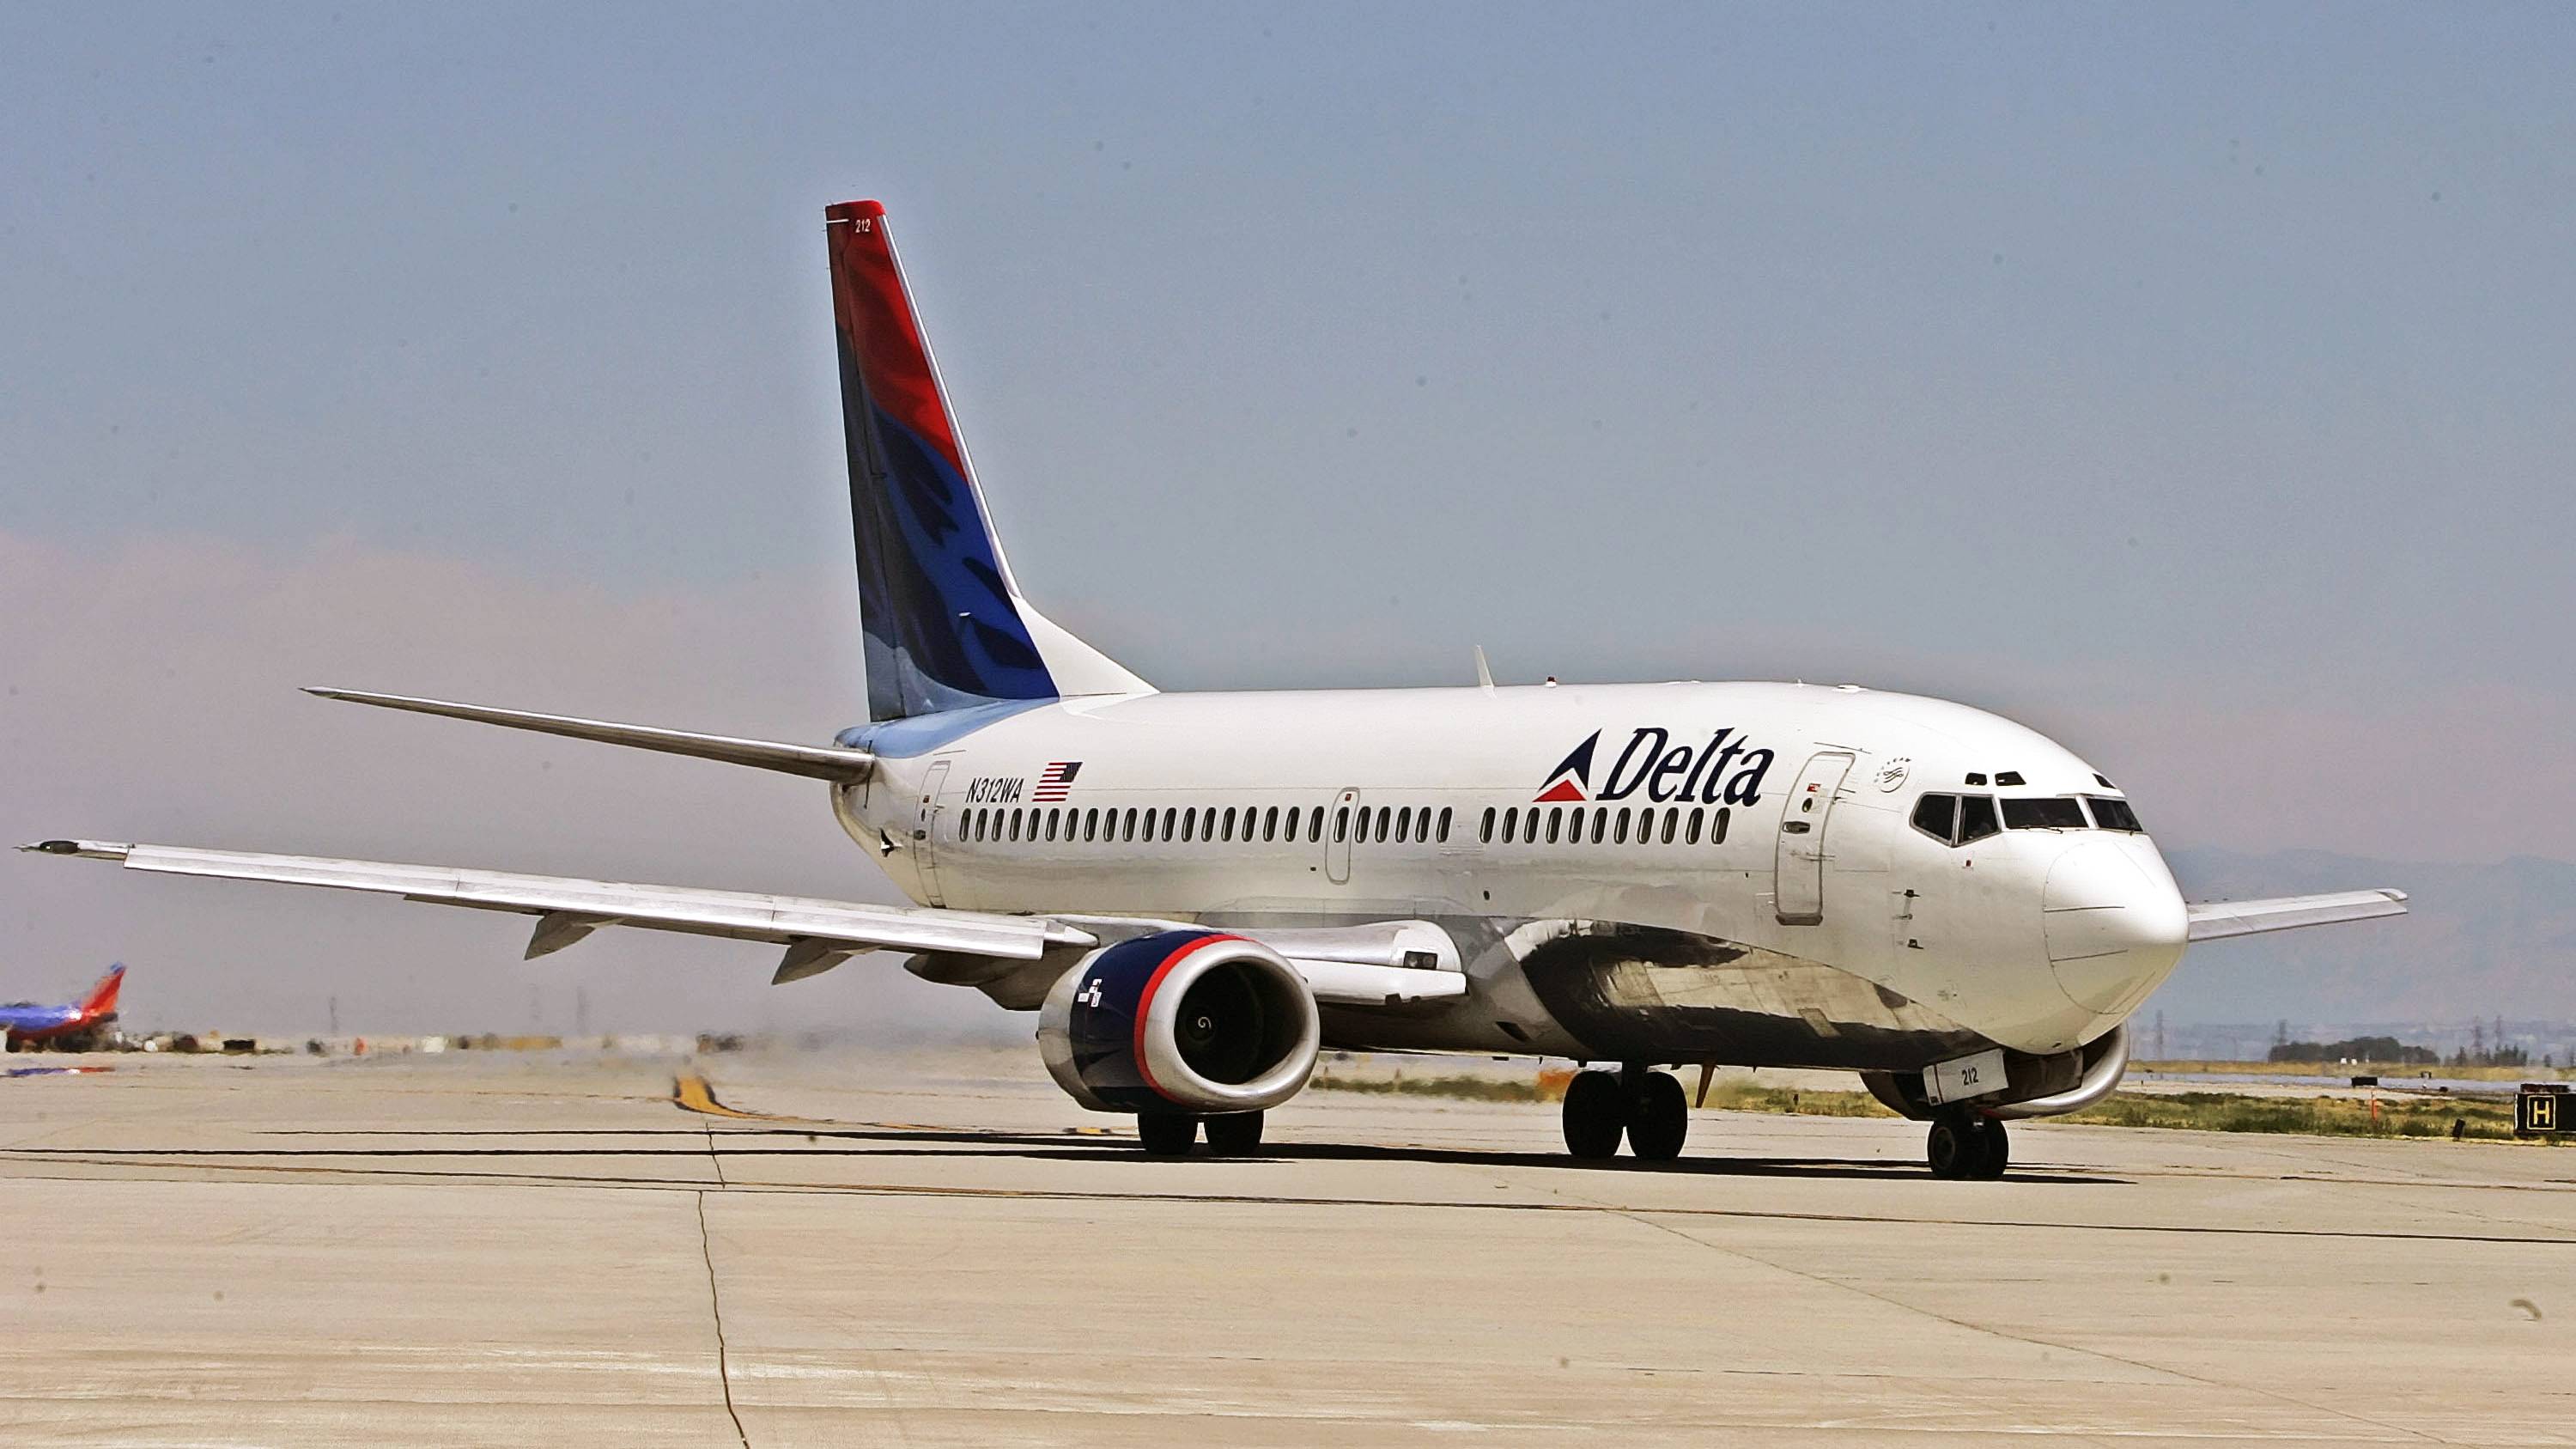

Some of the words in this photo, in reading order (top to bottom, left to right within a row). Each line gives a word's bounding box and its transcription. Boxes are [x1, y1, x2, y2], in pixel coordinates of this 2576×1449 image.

[855, 219, 871, 233] 212
[1595, 728, 1774, 807] Delta
[965, 777, 1024, 803] N312WA
[1962, 1067, 1979, 1086] 212
[2533, 1100, 2550, 1125] H
